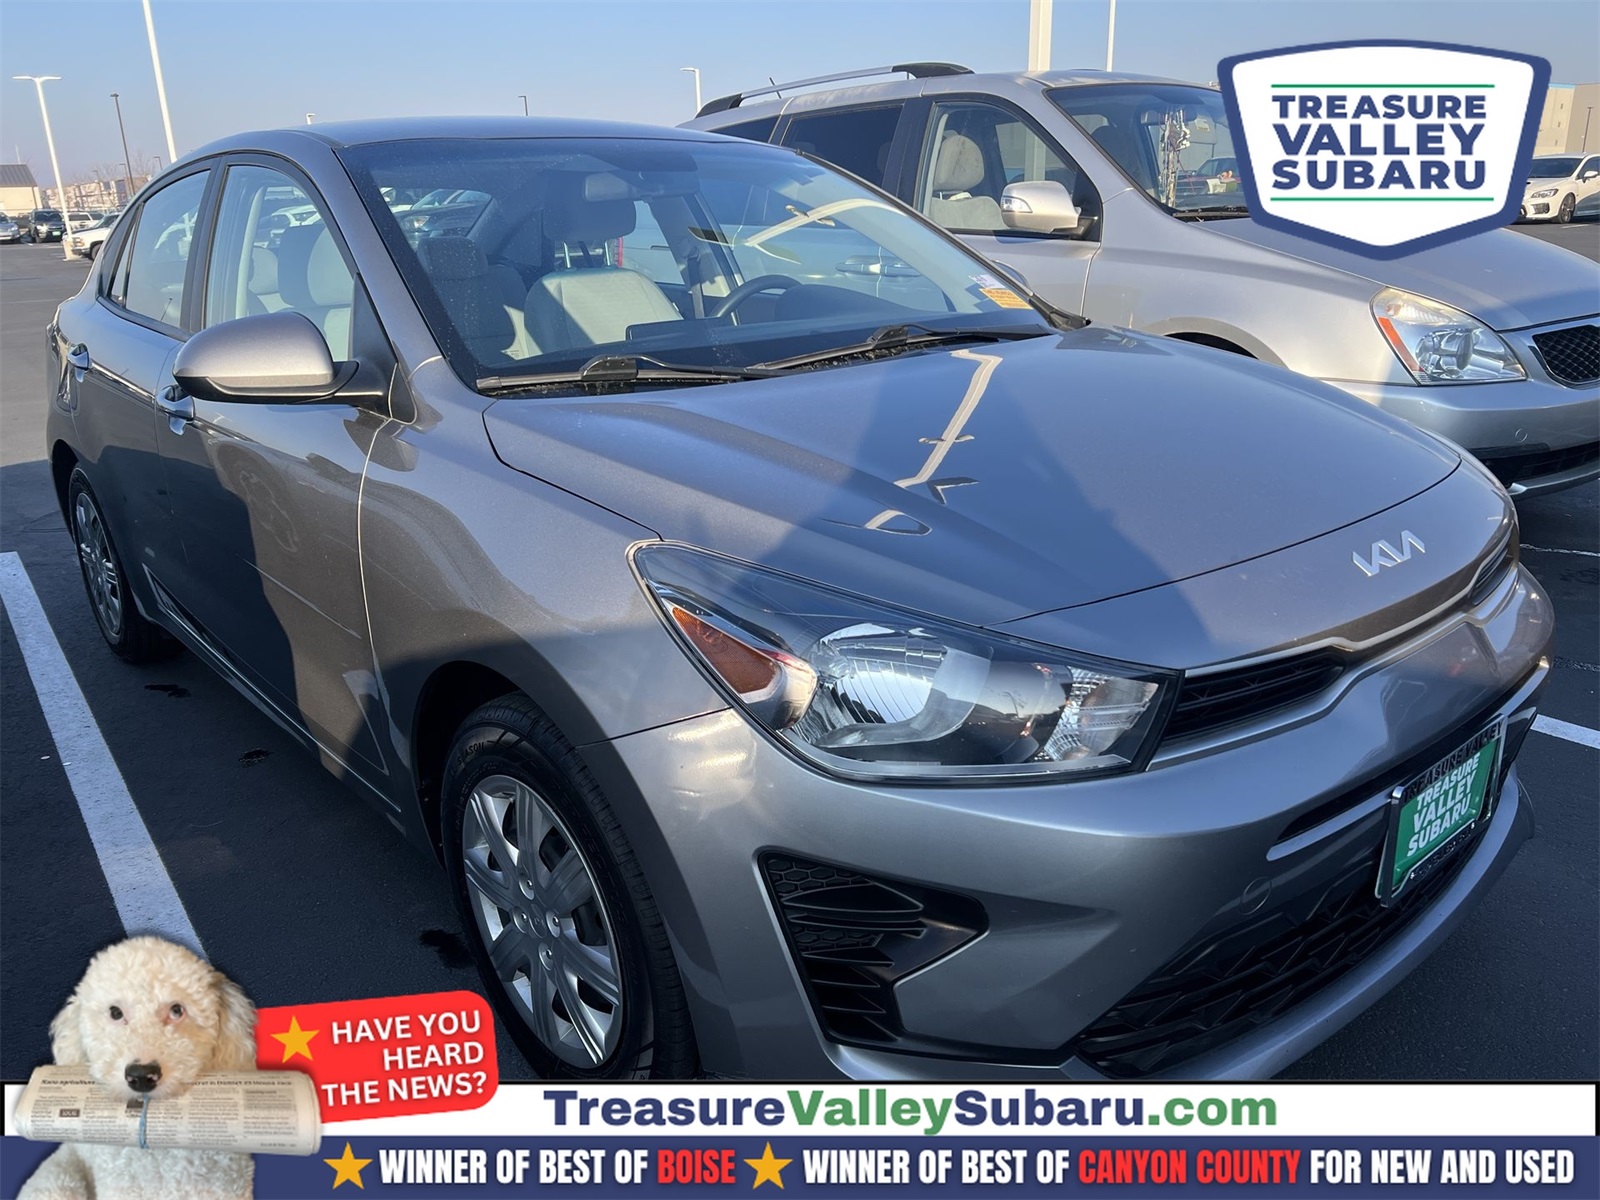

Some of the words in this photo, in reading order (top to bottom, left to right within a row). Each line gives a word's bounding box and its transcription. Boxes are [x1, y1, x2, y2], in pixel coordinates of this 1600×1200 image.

[1352, 529, 1426, 577] KIA
[1413, 770, 1477, 833] VALLEY
[1416, 752, 1480, 811] TREASURE
[1407, 793, 1471, 857] SUBARU
